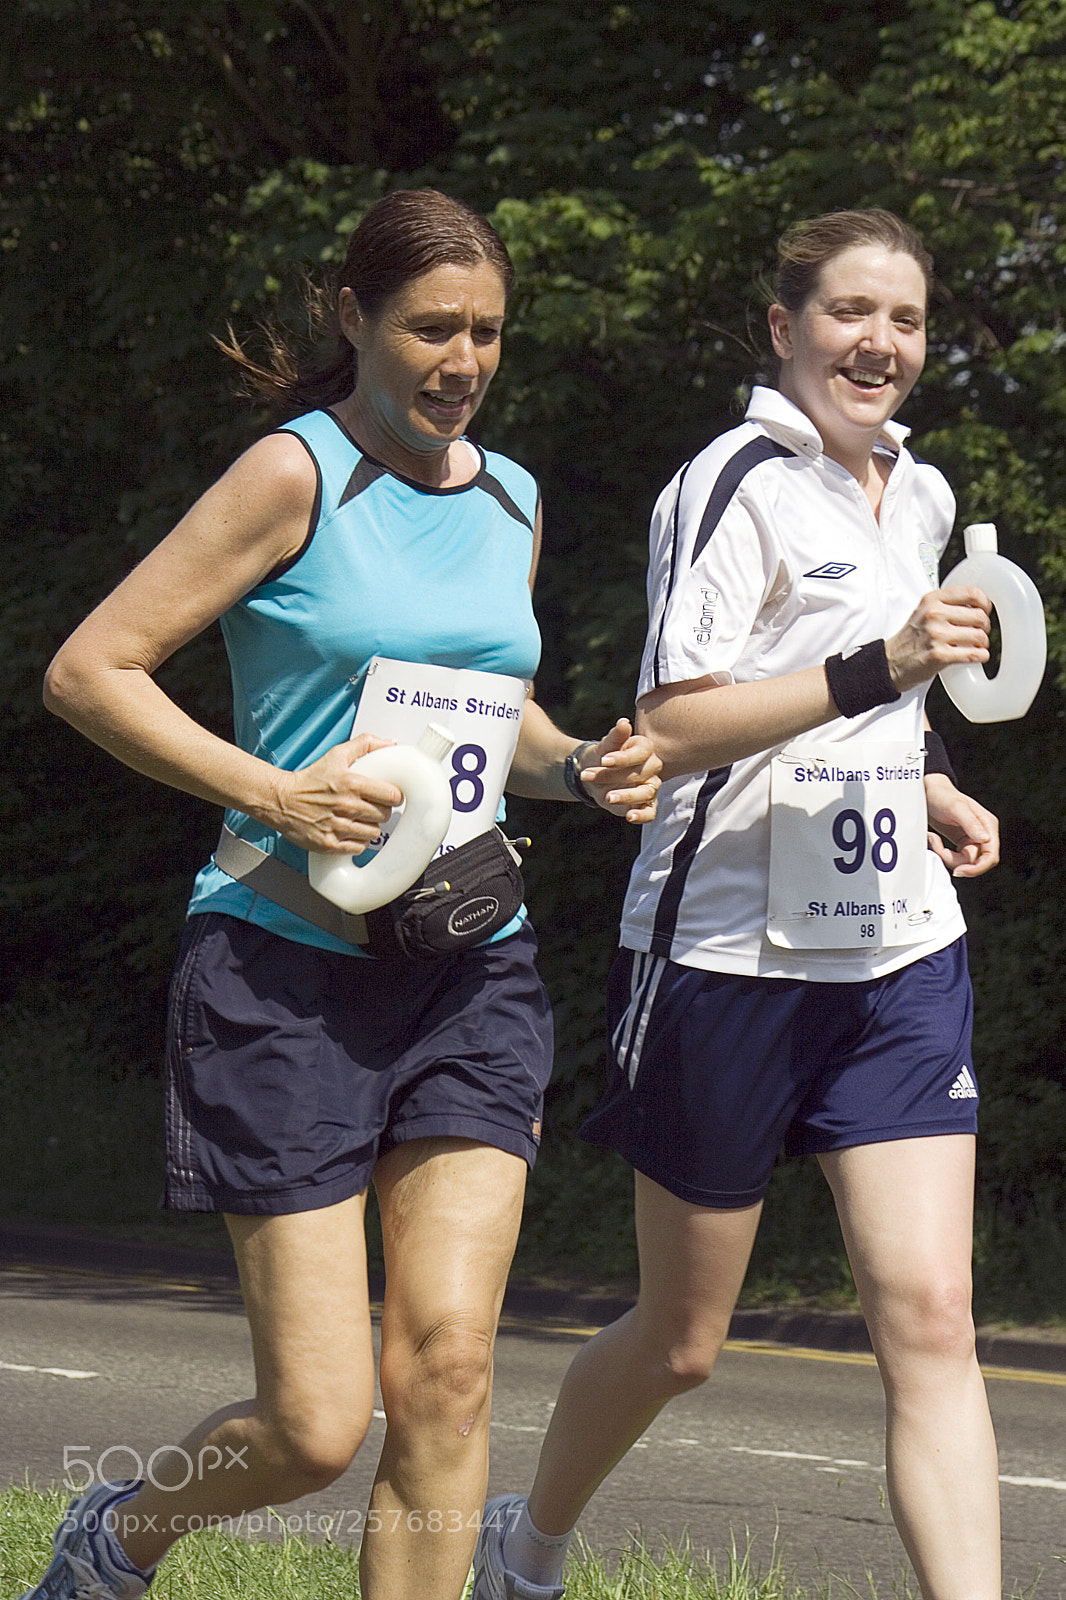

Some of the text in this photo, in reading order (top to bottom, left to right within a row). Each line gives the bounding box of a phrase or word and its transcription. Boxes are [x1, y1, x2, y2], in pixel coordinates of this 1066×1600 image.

[693, 587, 720, 651] eland
[385, 687, 520, 720] St Albans Striders
[449, 744, 487, 813] 8
[794, 766, 920, 782] St Albans Striders
[832, 808, 898, 875] 98
[454, 902, 495, 928] NATHAN
[807, 899, 908, 916] St Albans 10K
[860, 924, 876, 938] 98
